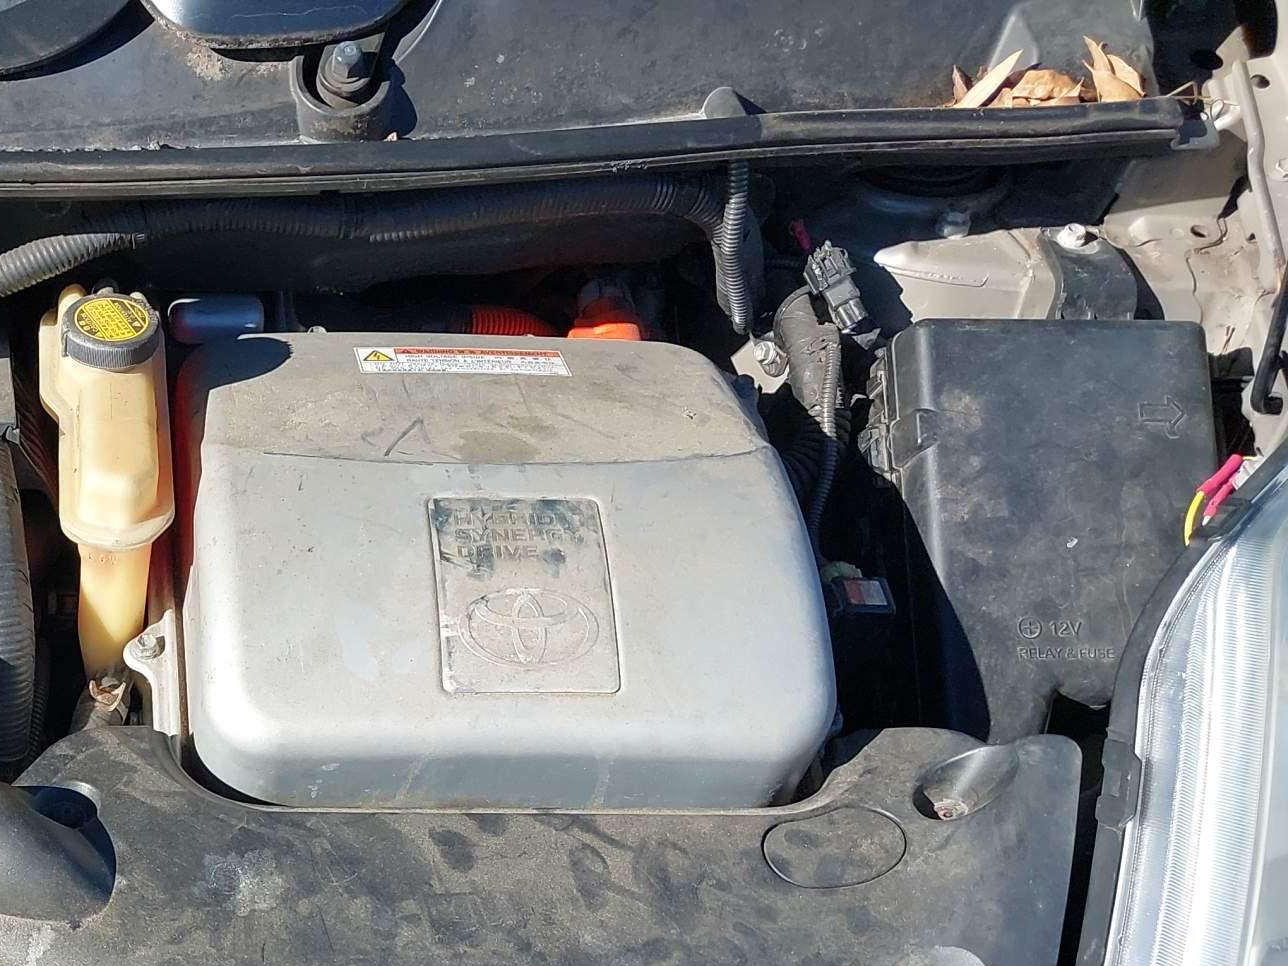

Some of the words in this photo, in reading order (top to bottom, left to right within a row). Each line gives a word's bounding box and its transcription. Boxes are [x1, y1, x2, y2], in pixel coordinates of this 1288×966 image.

[453, 511, 556, 526] HYBRID
[456, 544, 540, 560] DRIVE
[1049, 619, 1084, 638] 12V
[1017, 646, 1062, 661] RELAY
[1077, 647, 1116, 662] FUSE
